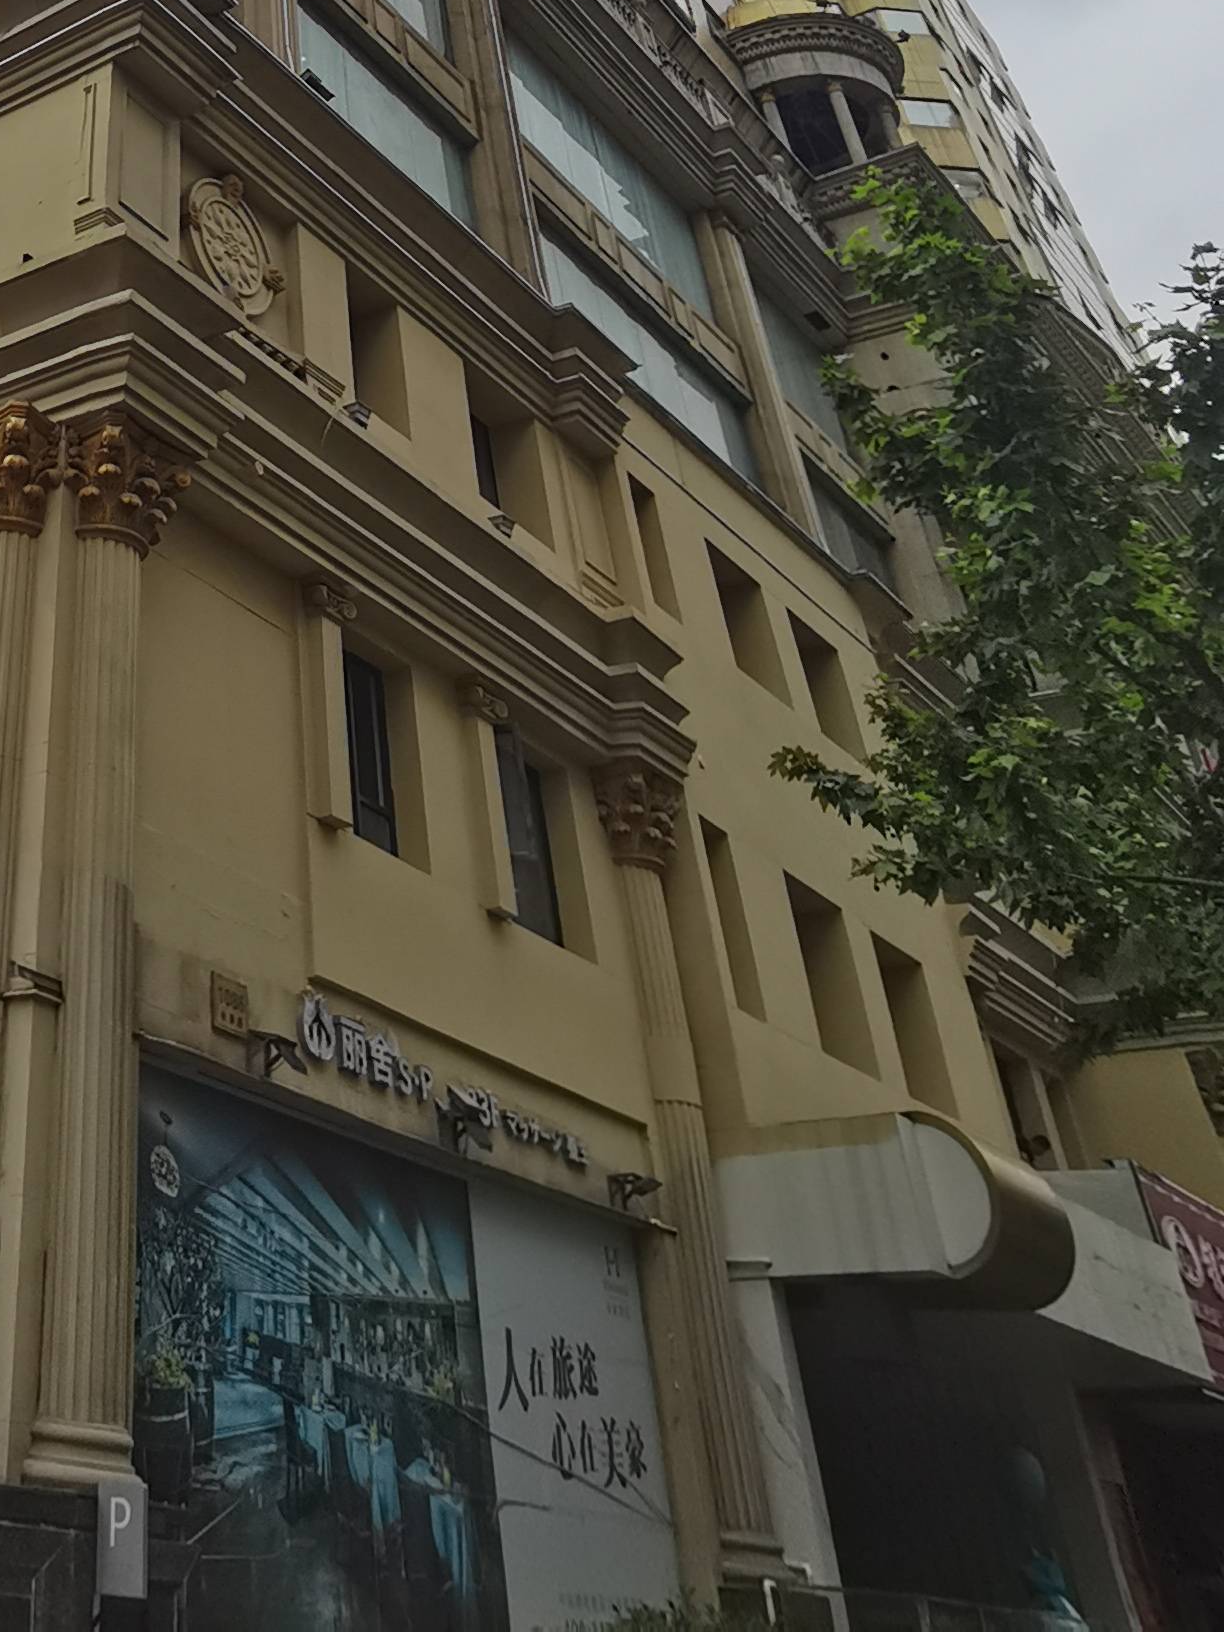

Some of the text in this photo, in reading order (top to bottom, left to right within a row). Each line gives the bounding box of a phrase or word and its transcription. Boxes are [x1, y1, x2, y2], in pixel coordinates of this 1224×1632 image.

[498, 1326, 599, 1413] 人在旅途
[109, 1496, 132, 1547] P
